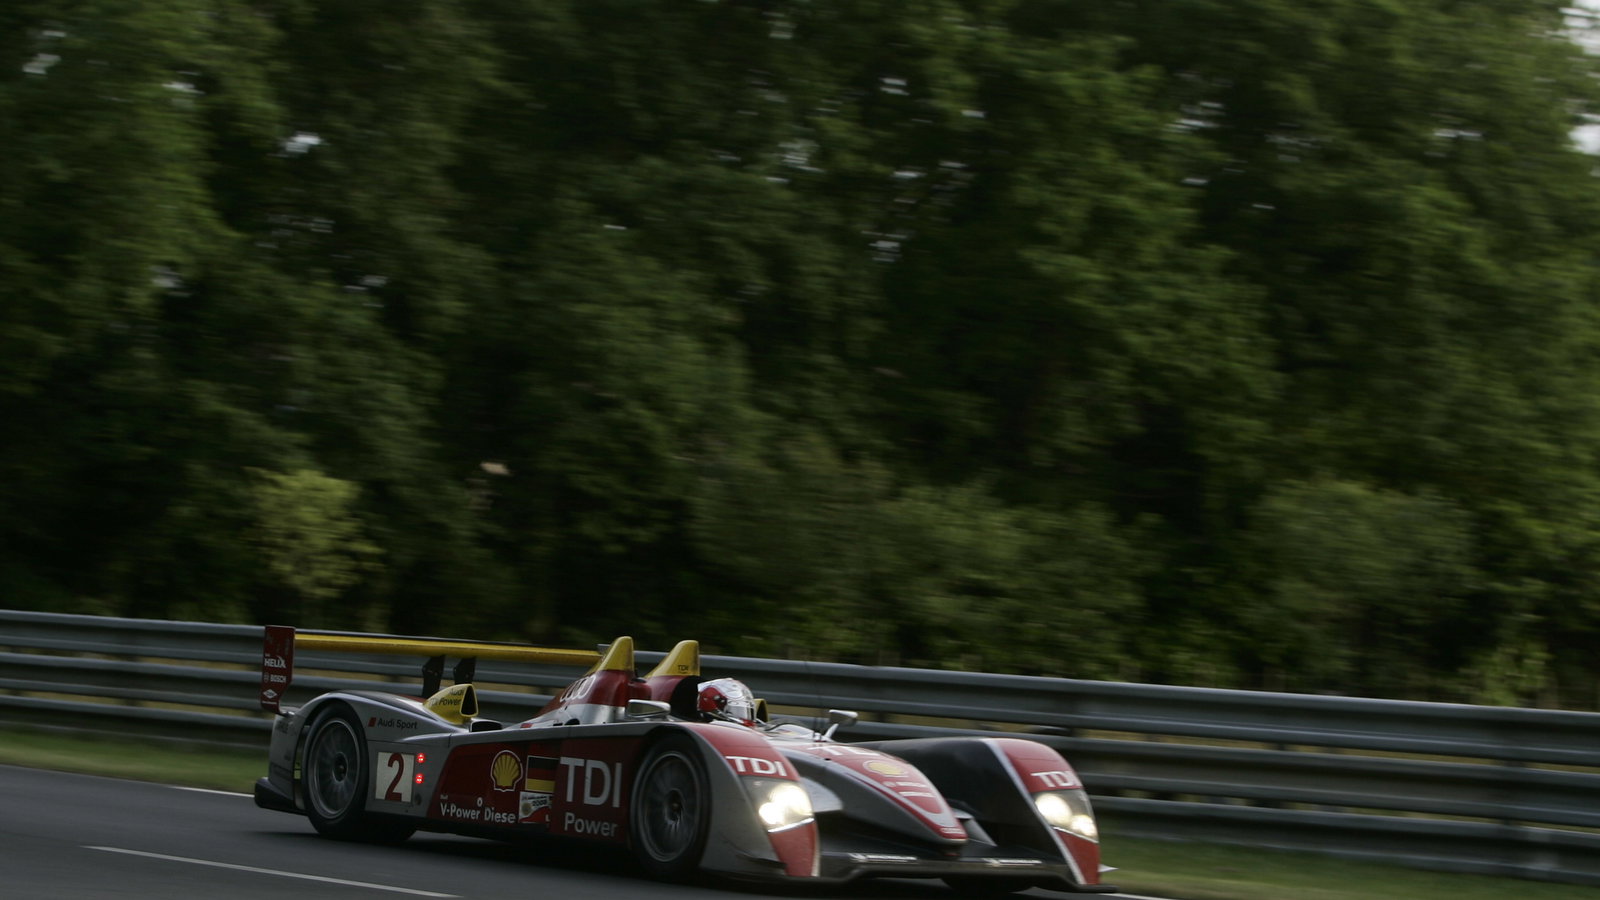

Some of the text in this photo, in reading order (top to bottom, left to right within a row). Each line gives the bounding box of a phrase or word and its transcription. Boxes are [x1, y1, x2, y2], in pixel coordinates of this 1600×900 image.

[264, 658, 286, 668] HELIX
[378, 718, 418, 729] Audi Sport
[385, 752, 405, 802] 2
[726, 756, 788, 776] TDI
[560, 756, 622, 808] TDI
[564, 812, 618, 837] Power
